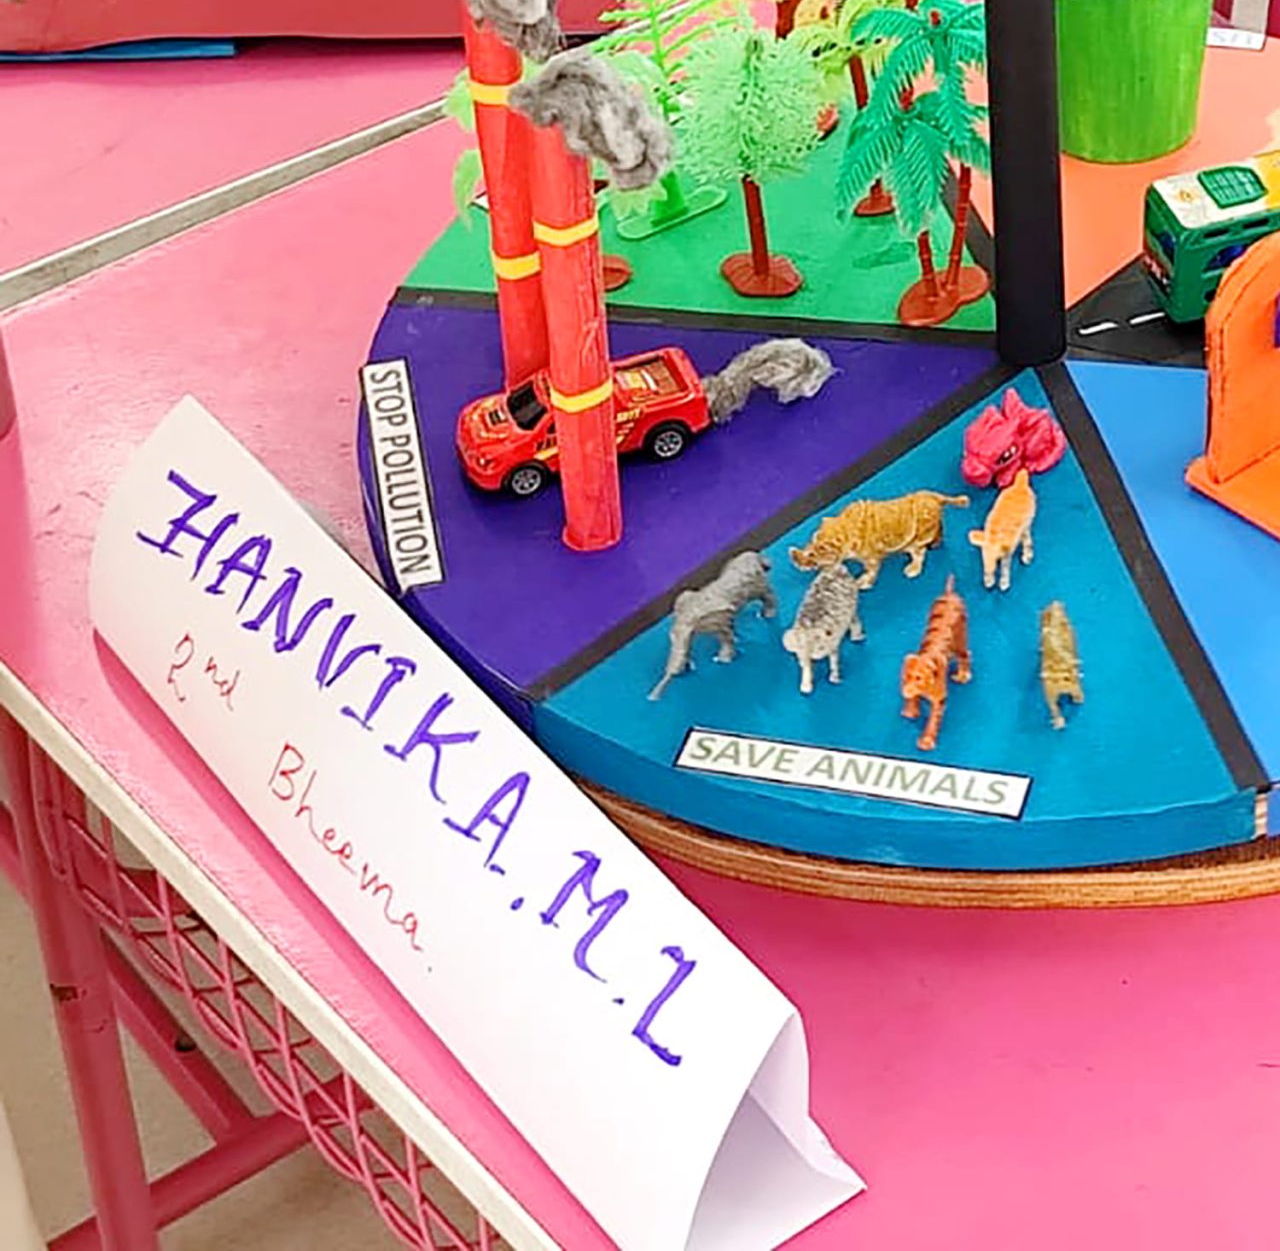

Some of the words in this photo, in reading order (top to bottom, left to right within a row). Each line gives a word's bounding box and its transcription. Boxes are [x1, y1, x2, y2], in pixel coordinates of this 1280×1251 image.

[370, 369, 408, 427] STOP
[380, 434, 431, 576] POLLUTION
[166, 633, 240, 712] 2nd
[689, 735, 799, 773] SAVE
[806, 753, 1009, 806] ANIMALS
